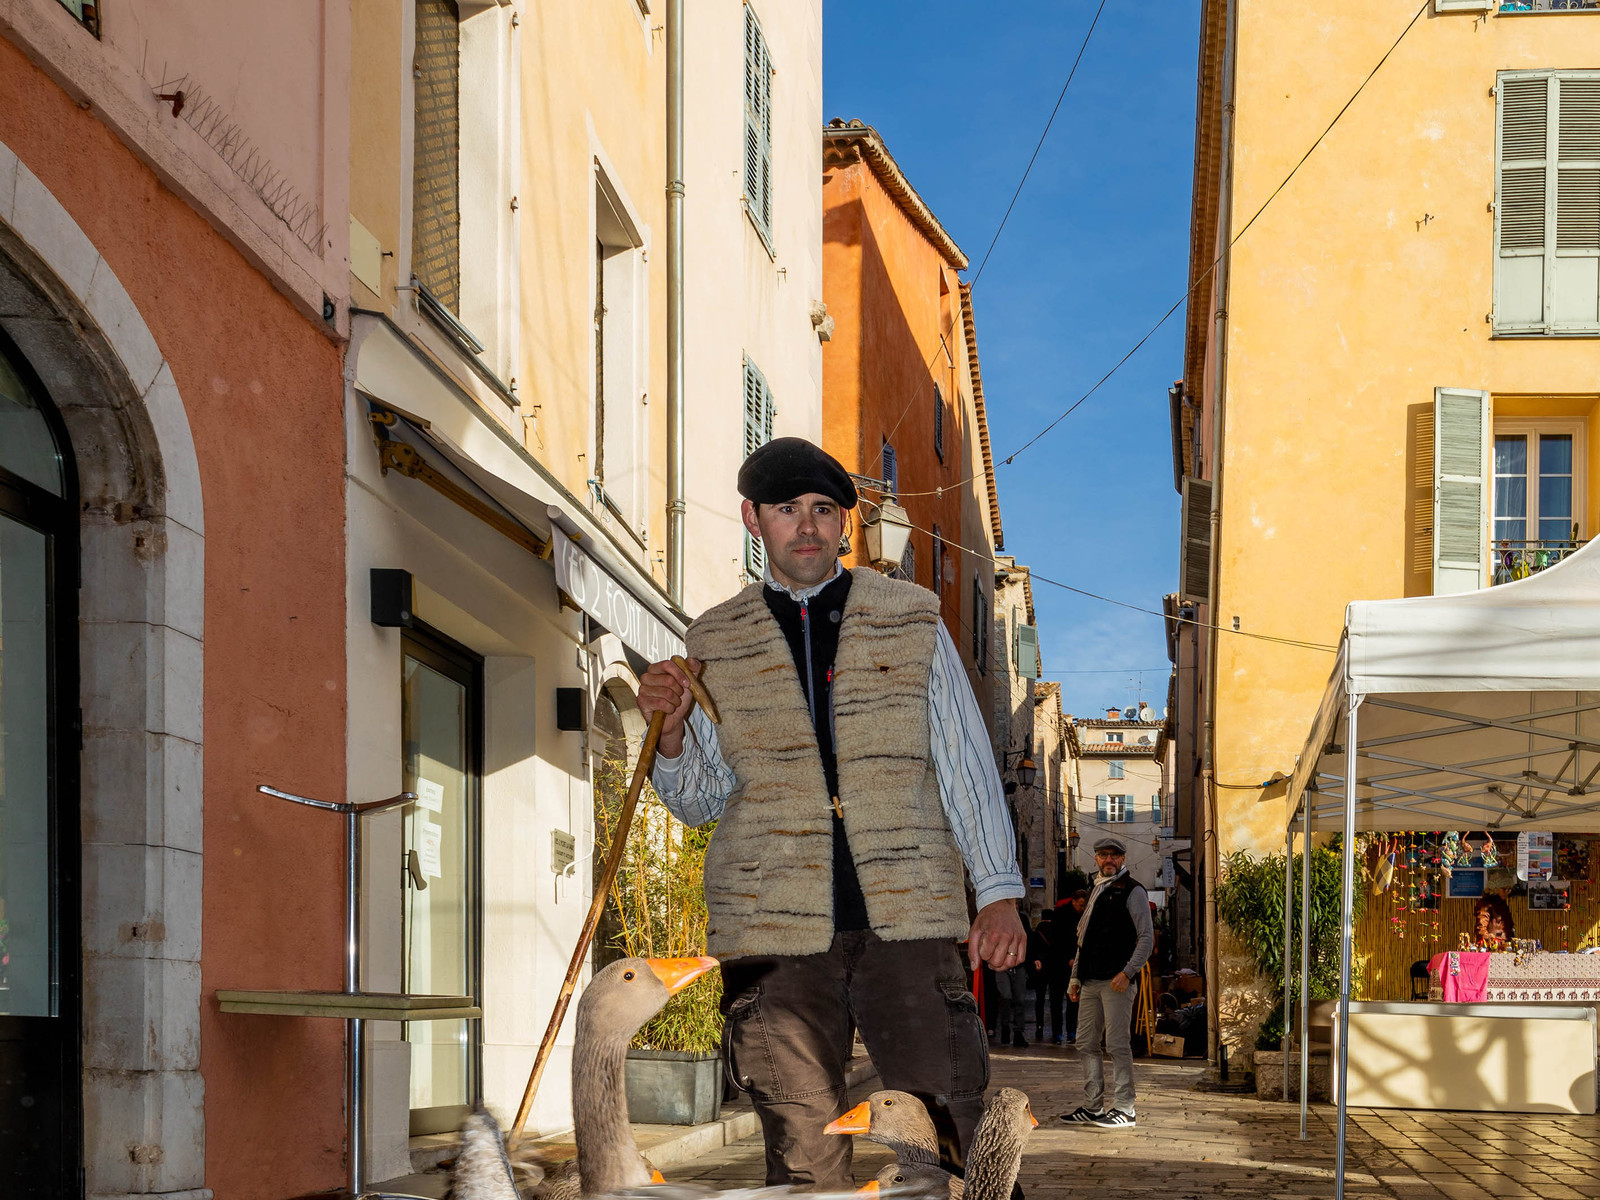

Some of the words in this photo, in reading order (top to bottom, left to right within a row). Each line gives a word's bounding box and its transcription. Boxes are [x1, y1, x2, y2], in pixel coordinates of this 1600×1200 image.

[591, 565, 602, 619] 2
[605, 579, 642, 650] FONT
[646, 614, 660, 664] LA
